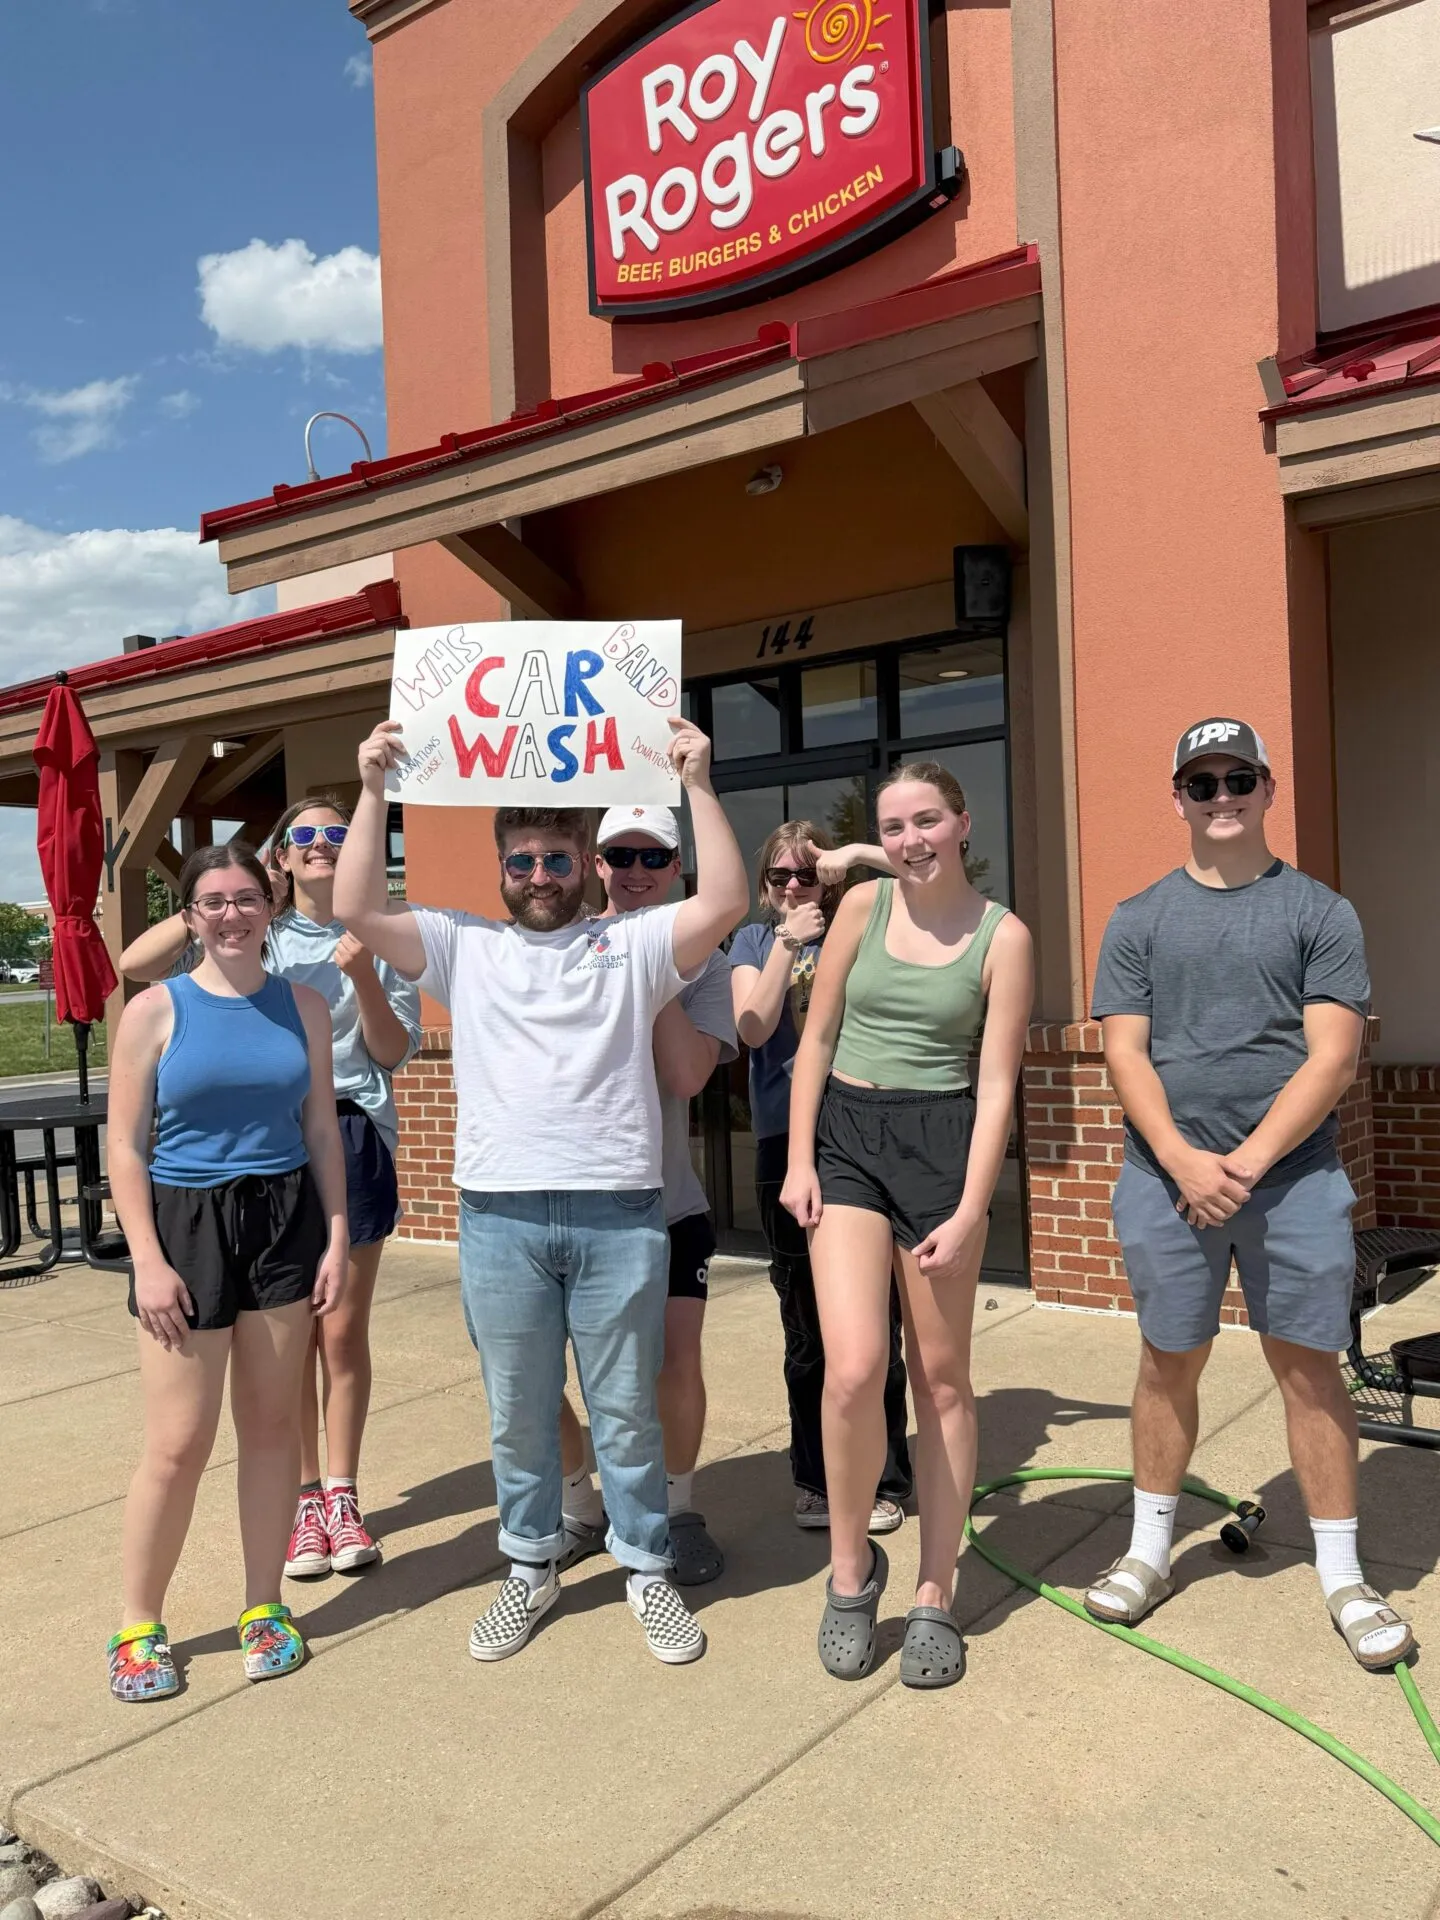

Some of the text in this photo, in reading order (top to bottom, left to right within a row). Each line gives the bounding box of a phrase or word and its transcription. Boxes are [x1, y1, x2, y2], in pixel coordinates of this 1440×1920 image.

[641, 16, 787, 152] Roy
[605, 65, 880, 260] Rogers
[617, 164, 884, 283] BEEF, BURGERS & CHICKEN
[393, 626, 483, 711] WHS
[603, 623, 678, 707] BAND
[756, 615, 815, 658] 144
[465, 649, 606, 718] CAR
[395, 735, 441, 782] DONATIONS
[447, 714, 625, 783] WASH
